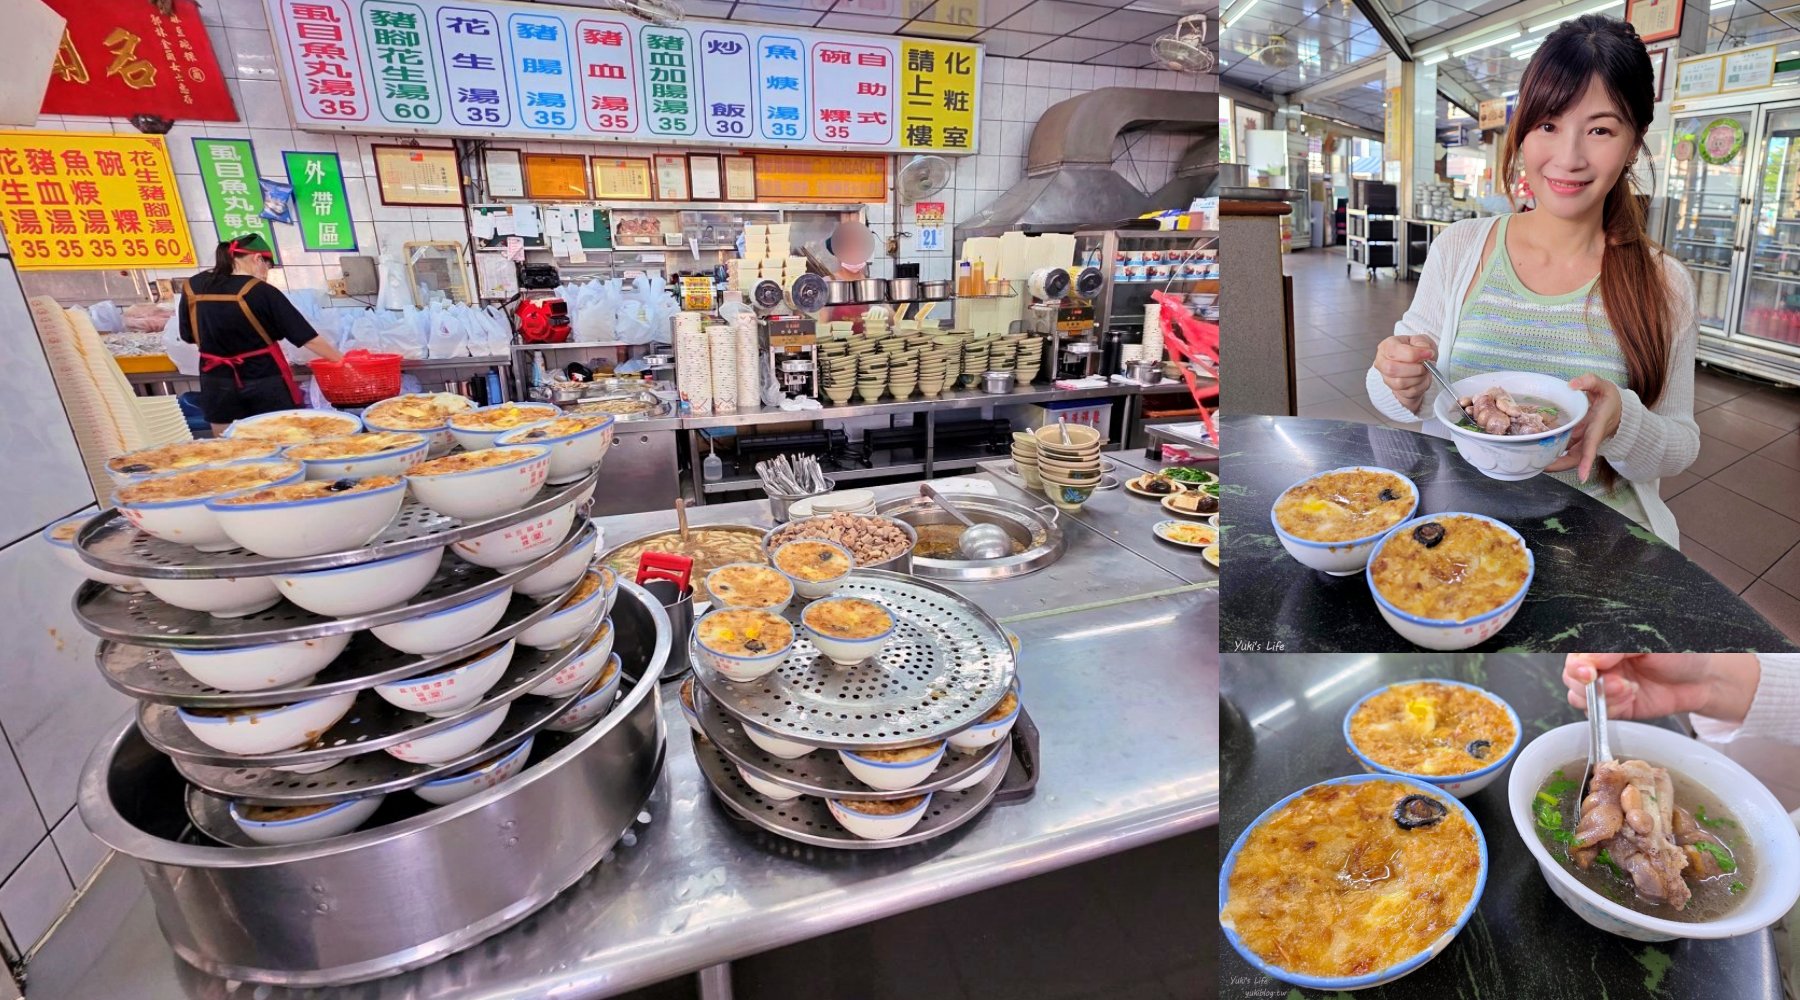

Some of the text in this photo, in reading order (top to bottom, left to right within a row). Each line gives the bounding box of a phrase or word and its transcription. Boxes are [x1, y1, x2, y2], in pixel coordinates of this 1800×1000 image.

[290, 2, 356, 97] 虱目魚丸湯
[369, 9, 430, 101] 豬腳花生湯
[445, 17, 500, 105] 花生湯
[516, 22, 566, 108] 豬腸湯
[583, 28, 630, 111] 豬血湯
[646, 34, 689, 115] 豬血加腸湯
[707, 40, 746, 118] 炒飯
[819, 49, 852, 124] 碗粿
[857, 53, 887, 125] 自助式
[319, 99, 357, 116] 35
[394, 103, 430, 119] 60
[467, 107, 500, 122] 35
[534, 111, 566, 125] 35
[906, 48, 935, 147] 請上二樓
[943, 51, 971, 148] 化粧室
[599, 114, 629, 129] 35
[659, 117, 687, 131] 35
[716, 120, 743, 134] 30
[771, 123, 798, 136] 35
[825, 126, 849, 139] 35
[23, 148, 77, 235] 豬血湯
[93, 150, 144, 235] 碗粿
[128, 150, 175, 235] 花生豬腳湯
[209, 144, 254, 211] 虱目魚丸
[223, 213, 265, 228] 每包
[304, 160, 340, 246] 外帶區
[21, 240, 50, 258] 35
[56, 240, 84, 258] 35
[89, 239, 117, 258] 35
[123, 239, 149, 257] 35
[155, 238, 181, 256] 60
[923, 229, 936, 246] 21
